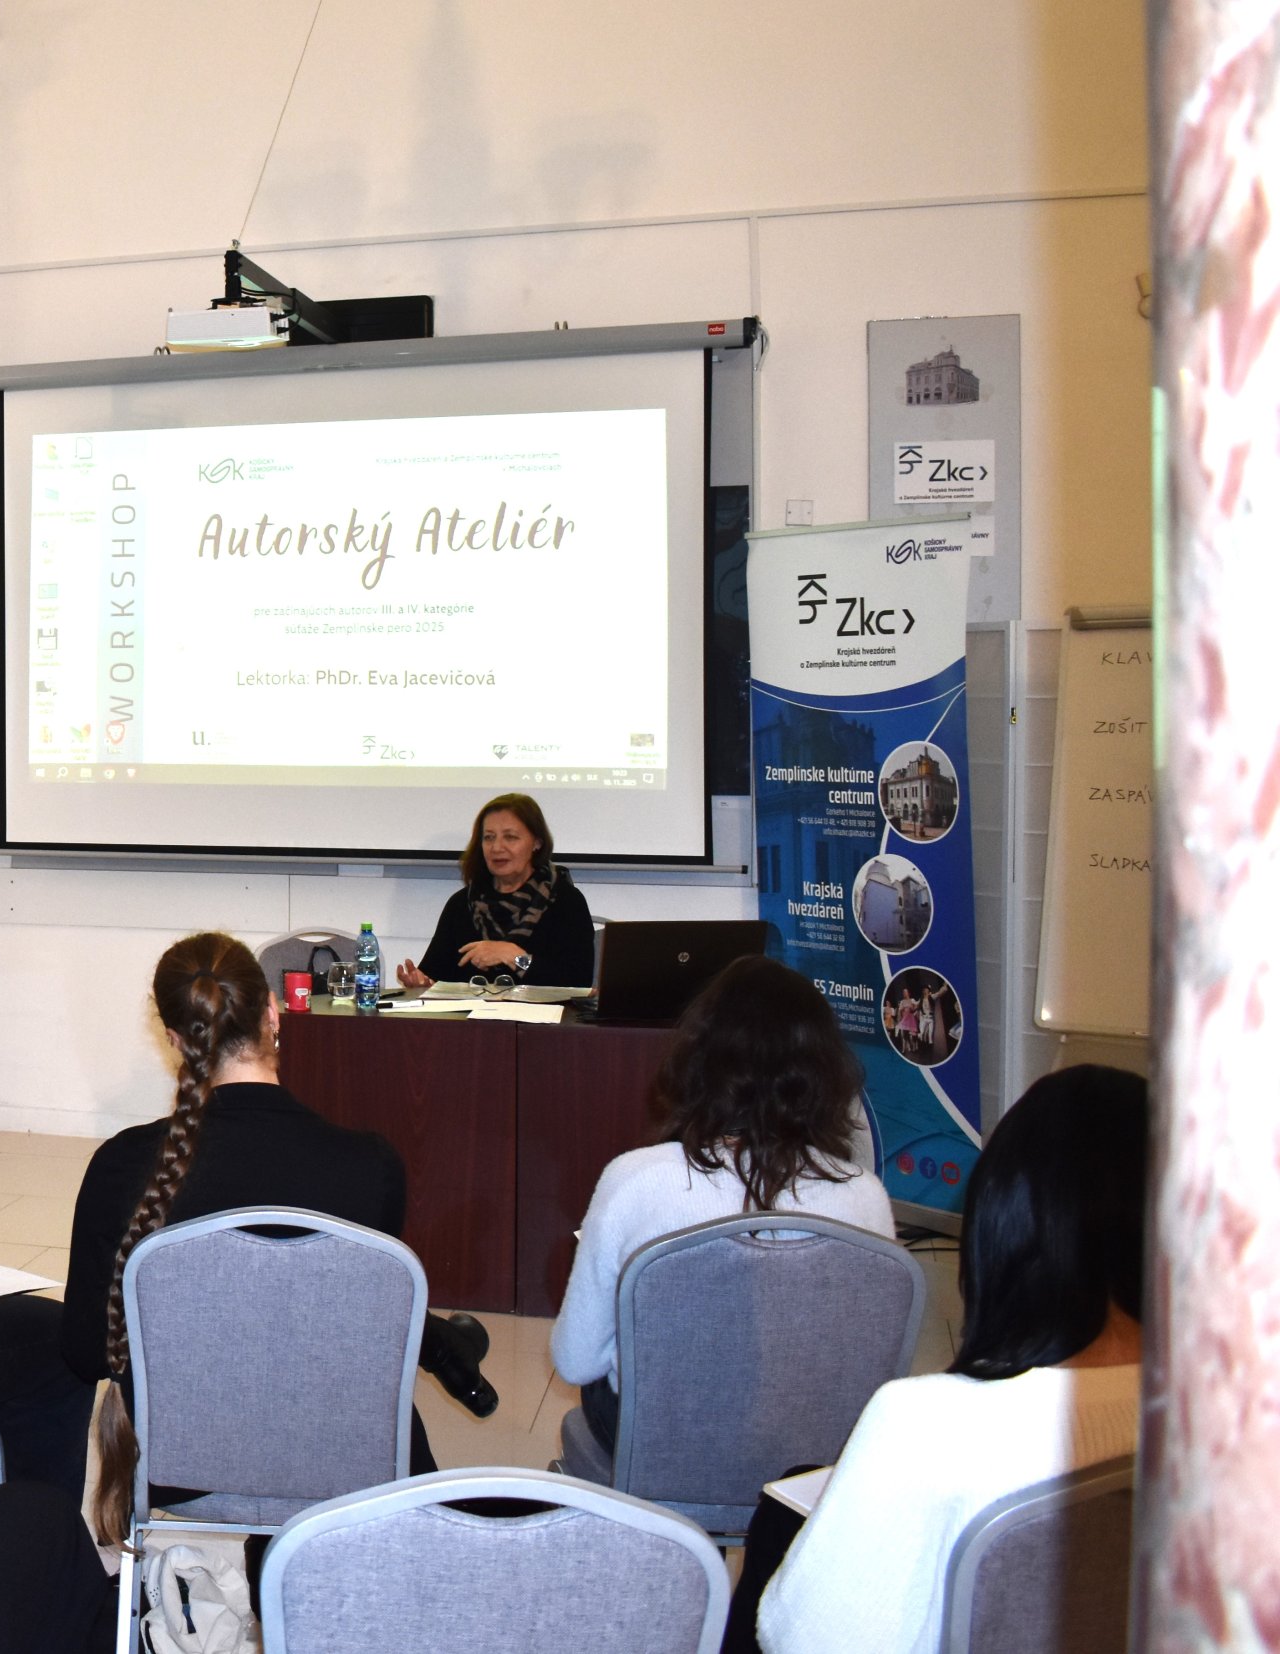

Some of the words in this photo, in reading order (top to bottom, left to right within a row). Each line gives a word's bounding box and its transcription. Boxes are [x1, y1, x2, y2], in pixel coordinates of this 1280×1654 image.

[197, 508, 395, 590] Autorský
[414, 501, 576, 554] Ateliér
[924, 545, 963, 553] SAMOSPRÁVNY
[109, 472, 136, 723] WORKSHOP
[253, 607, 271, 618] pre
[338, 606, 379, 616] autorov
[381, 603, 395, 614] III.
[398, 606, 405, 614] a
[407, 603, 421, 614] IV.
[423, 602, 475, 616] kategórie
[835, 597, 896, 637] Zkc
[322, 622, 385, 637] Zemplínske
[387, 624, 413, 637] pero
[415, 621, 445, 633] 2025
[836, 647, 861, 658] Krajská
[862, 645, 896, 656] hvezdáreň
[806, 659, 841, 670] Zemplínske
[841, 659, 868, 668] kultúrne
[869, 659, 897, 667] centrum
[236, 669, 310, 686] Lektorka:
[315, 669, 362, 686] PhDr.
[367, 669, 399, 686] Eva
[402, 668, 497, 689] Jacevičová
[1092, 716, 1148, 734] ZOŠIT
[516, 744, 562, 752] TALENTY
[764, 764, 826, 785] Zemplínske
[827, 765, 875, 784] kultúrne
[828, 788, 875, 805] centrum
[802, 881, 844, 900] Krajská
[787, 898, 844, 920] hvezdáreň
[828, 980, 874, 1002] Zemplín
